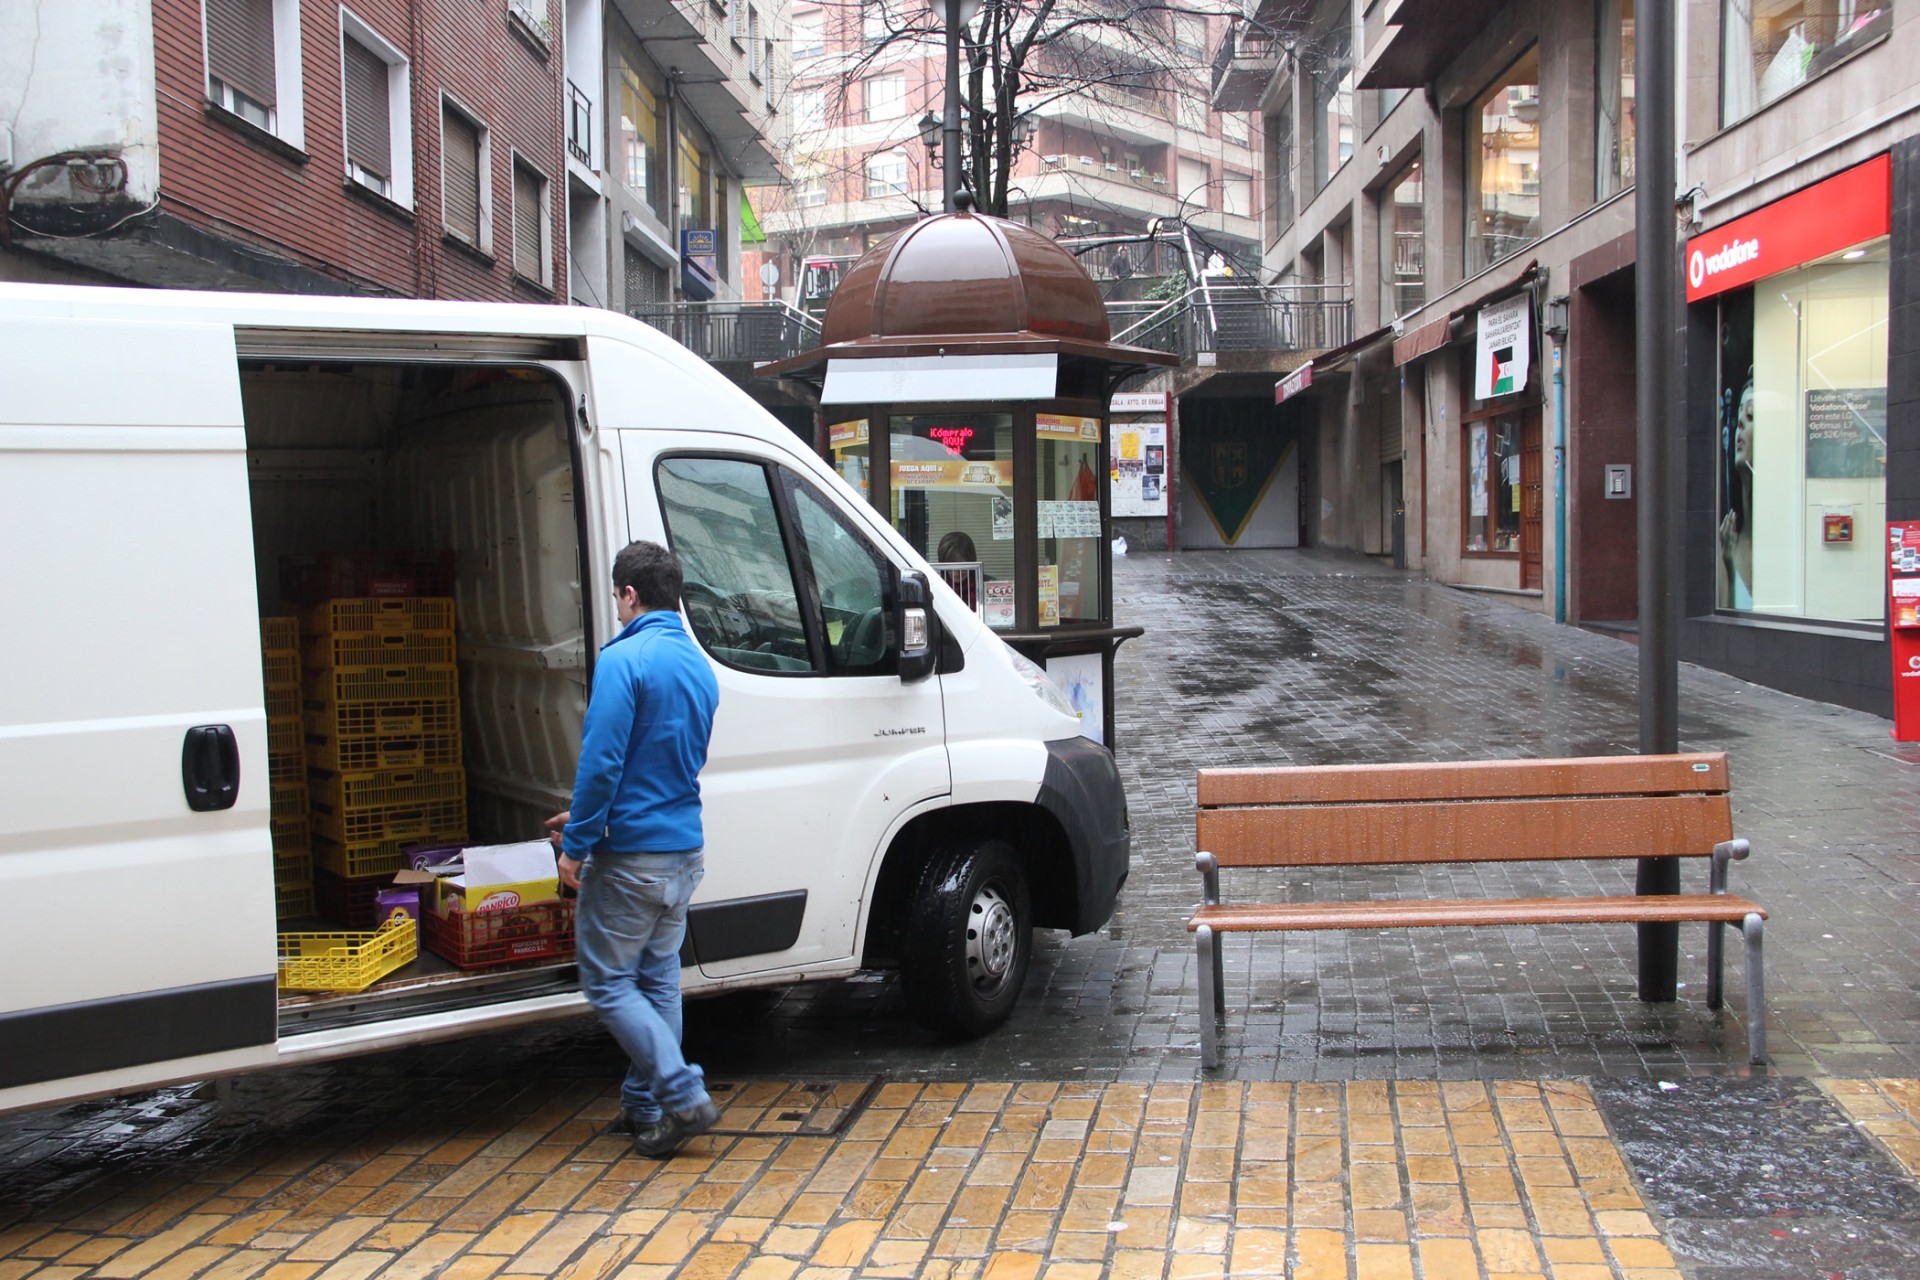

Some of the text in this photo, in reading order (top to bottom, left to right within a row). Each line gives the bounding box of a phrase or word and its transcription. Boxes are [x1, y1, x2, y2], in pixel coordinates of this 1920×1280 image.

[1705, 238, 1759, 275] vodafone
[1503, 309, 1519, 322] SAHARA
[1809, 402, 1847, 411] Vodafone
[1841, 412, 1852, 420] LG
[1809, 421, 1841, 431] Optimus
[1809, 432, 1823, 440] por
[511, 940, 539, 949] PROPIEDAD
[514, 946, 536, 954] PANRICO
